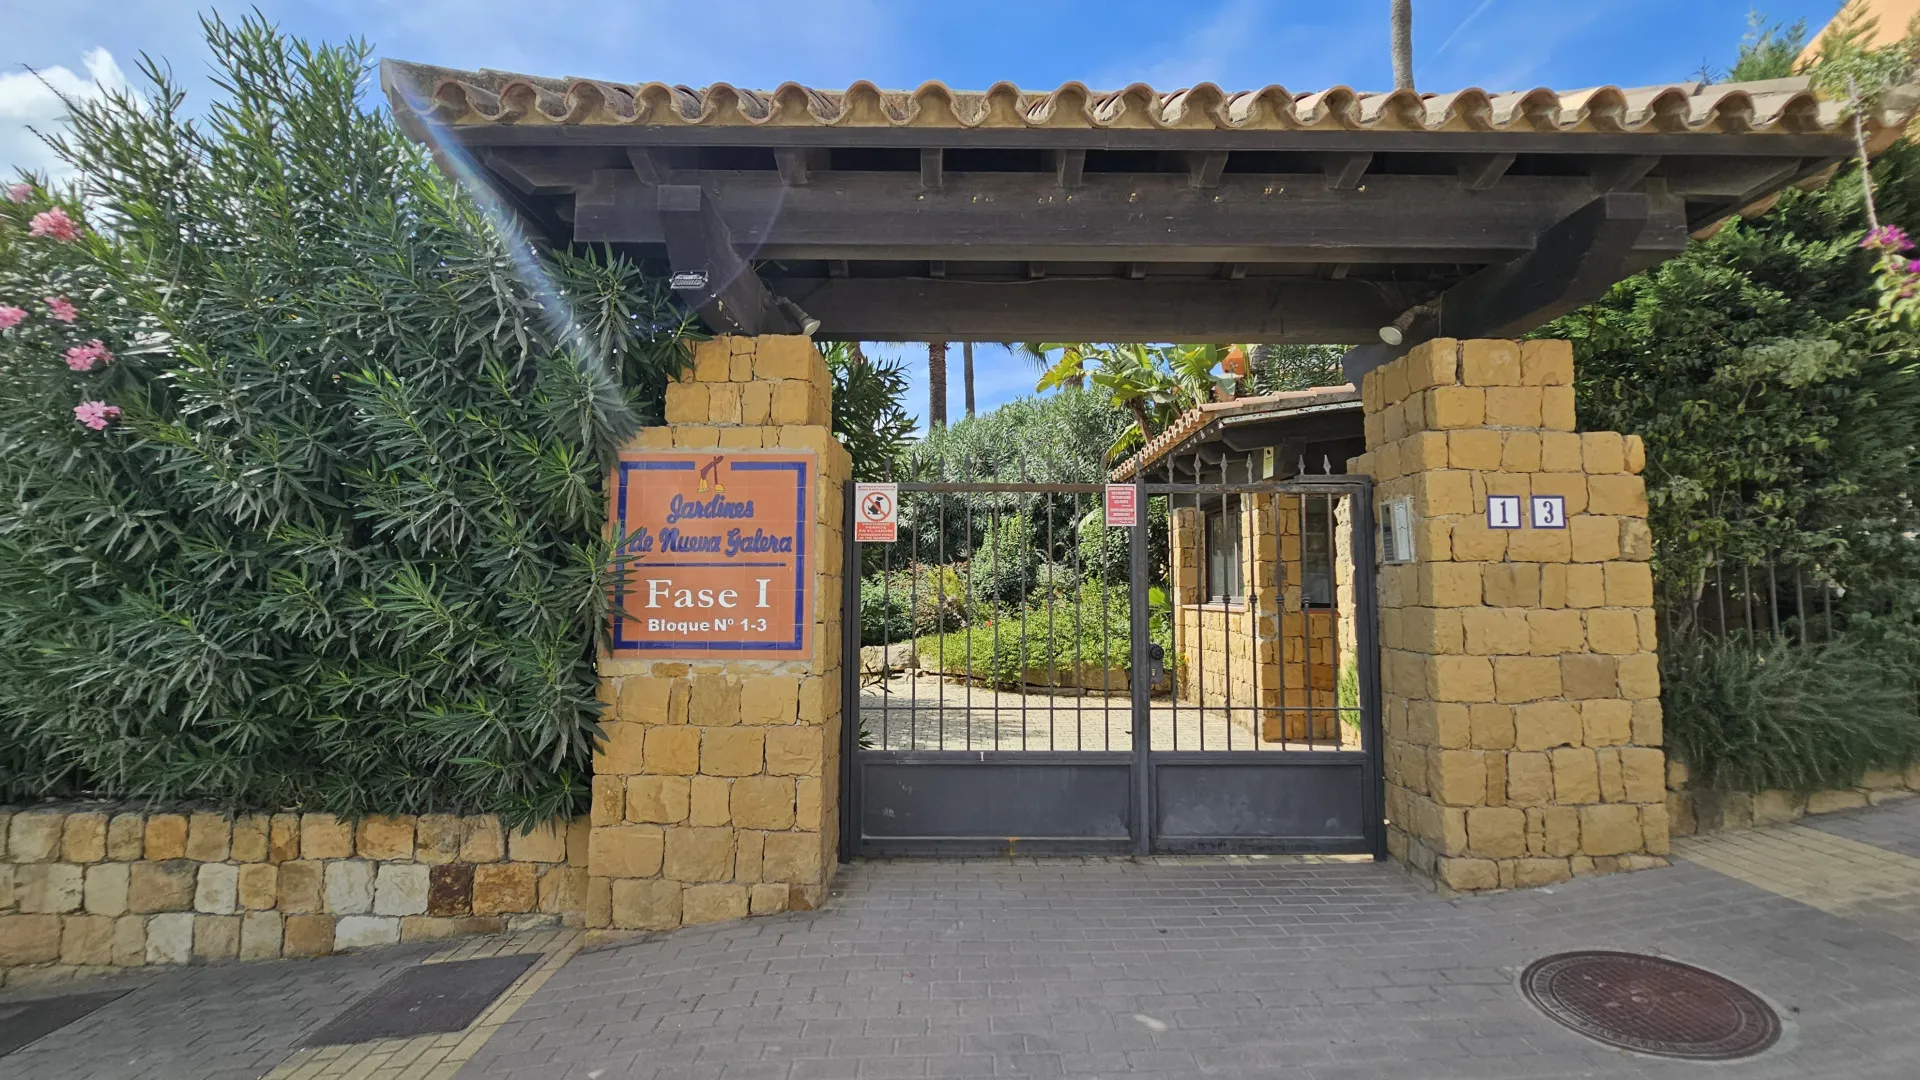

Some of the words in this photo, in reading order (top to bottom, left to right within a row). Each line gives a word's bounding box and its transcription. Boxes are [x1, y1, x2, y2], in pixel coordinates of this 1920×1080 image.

[666, 493, 755, 524] Jardines
[1500, 500, 1509, 524] 1
[1543, 500, 1554, 524] 3
[628, 527, 654, 552] de
[659, 527, 722, 553] Nueva
[725, 528, 793, 557] Galera
[644, 579, 738, 609] Fase
[755, 578, 771, 608] I
[648, 618, 710, 635] Bloque
[740, 618, 767, 631] 1-3
